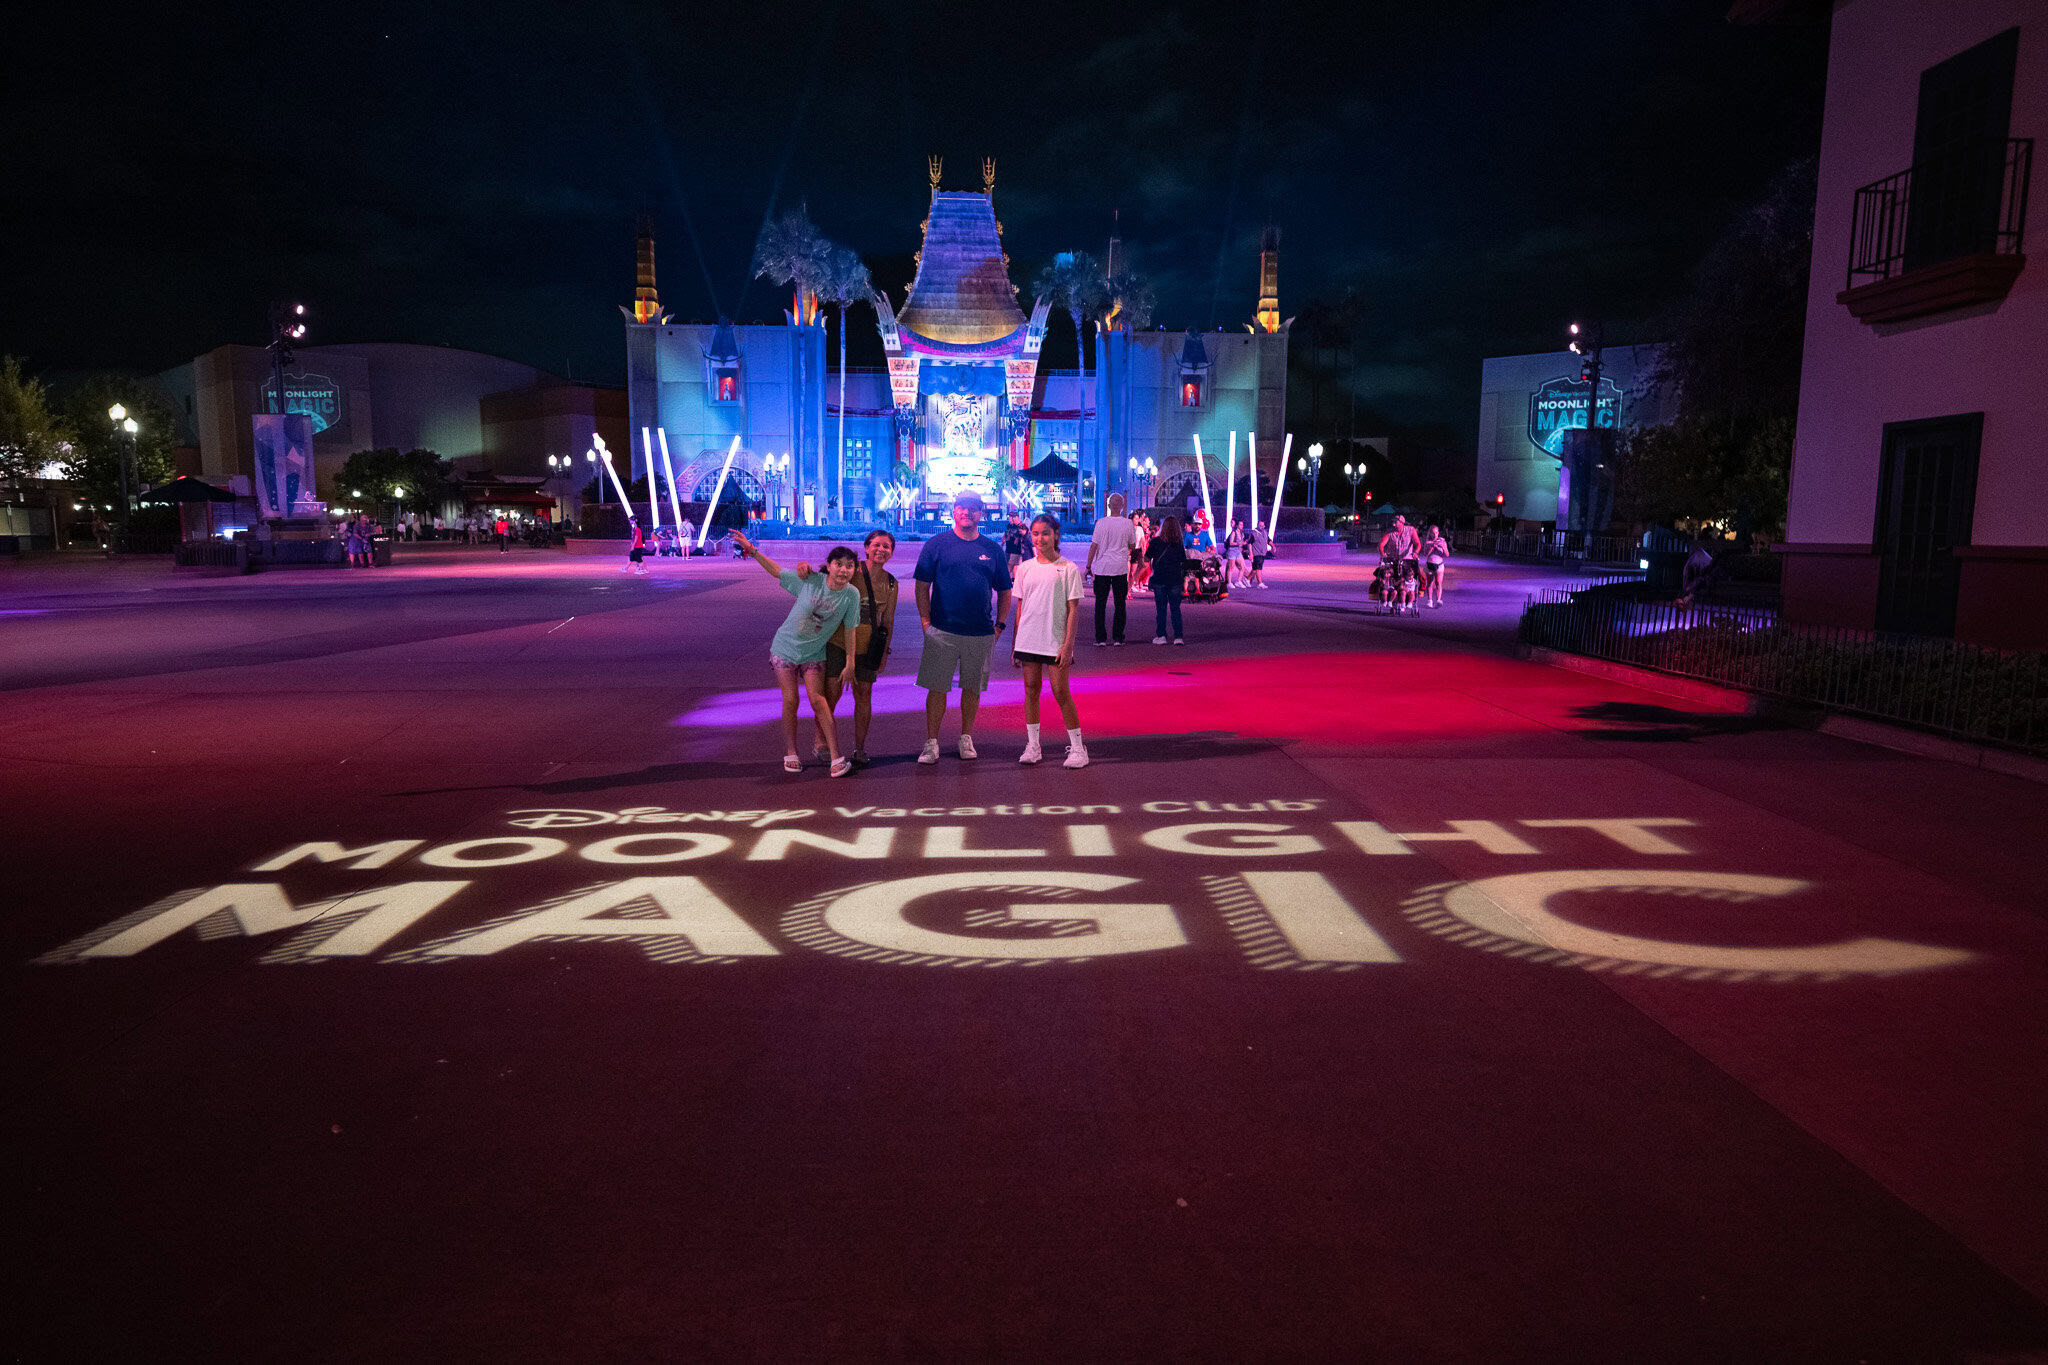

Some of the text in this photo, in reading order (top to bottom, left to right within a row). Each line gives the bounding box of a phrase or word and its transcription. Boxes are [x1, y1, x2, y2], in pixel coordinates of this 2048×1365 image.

[1538, 398, 1615, 409] MOONLIHT
[1537, 409, 1613, 430] MAGC
[506, 807, 817, 829] Disney
[833, 804, 1123, 818] Vacation
[251, 819, 1700, 872] MOONLIGHT
[36, 869, 1982, 980] MAGIC
